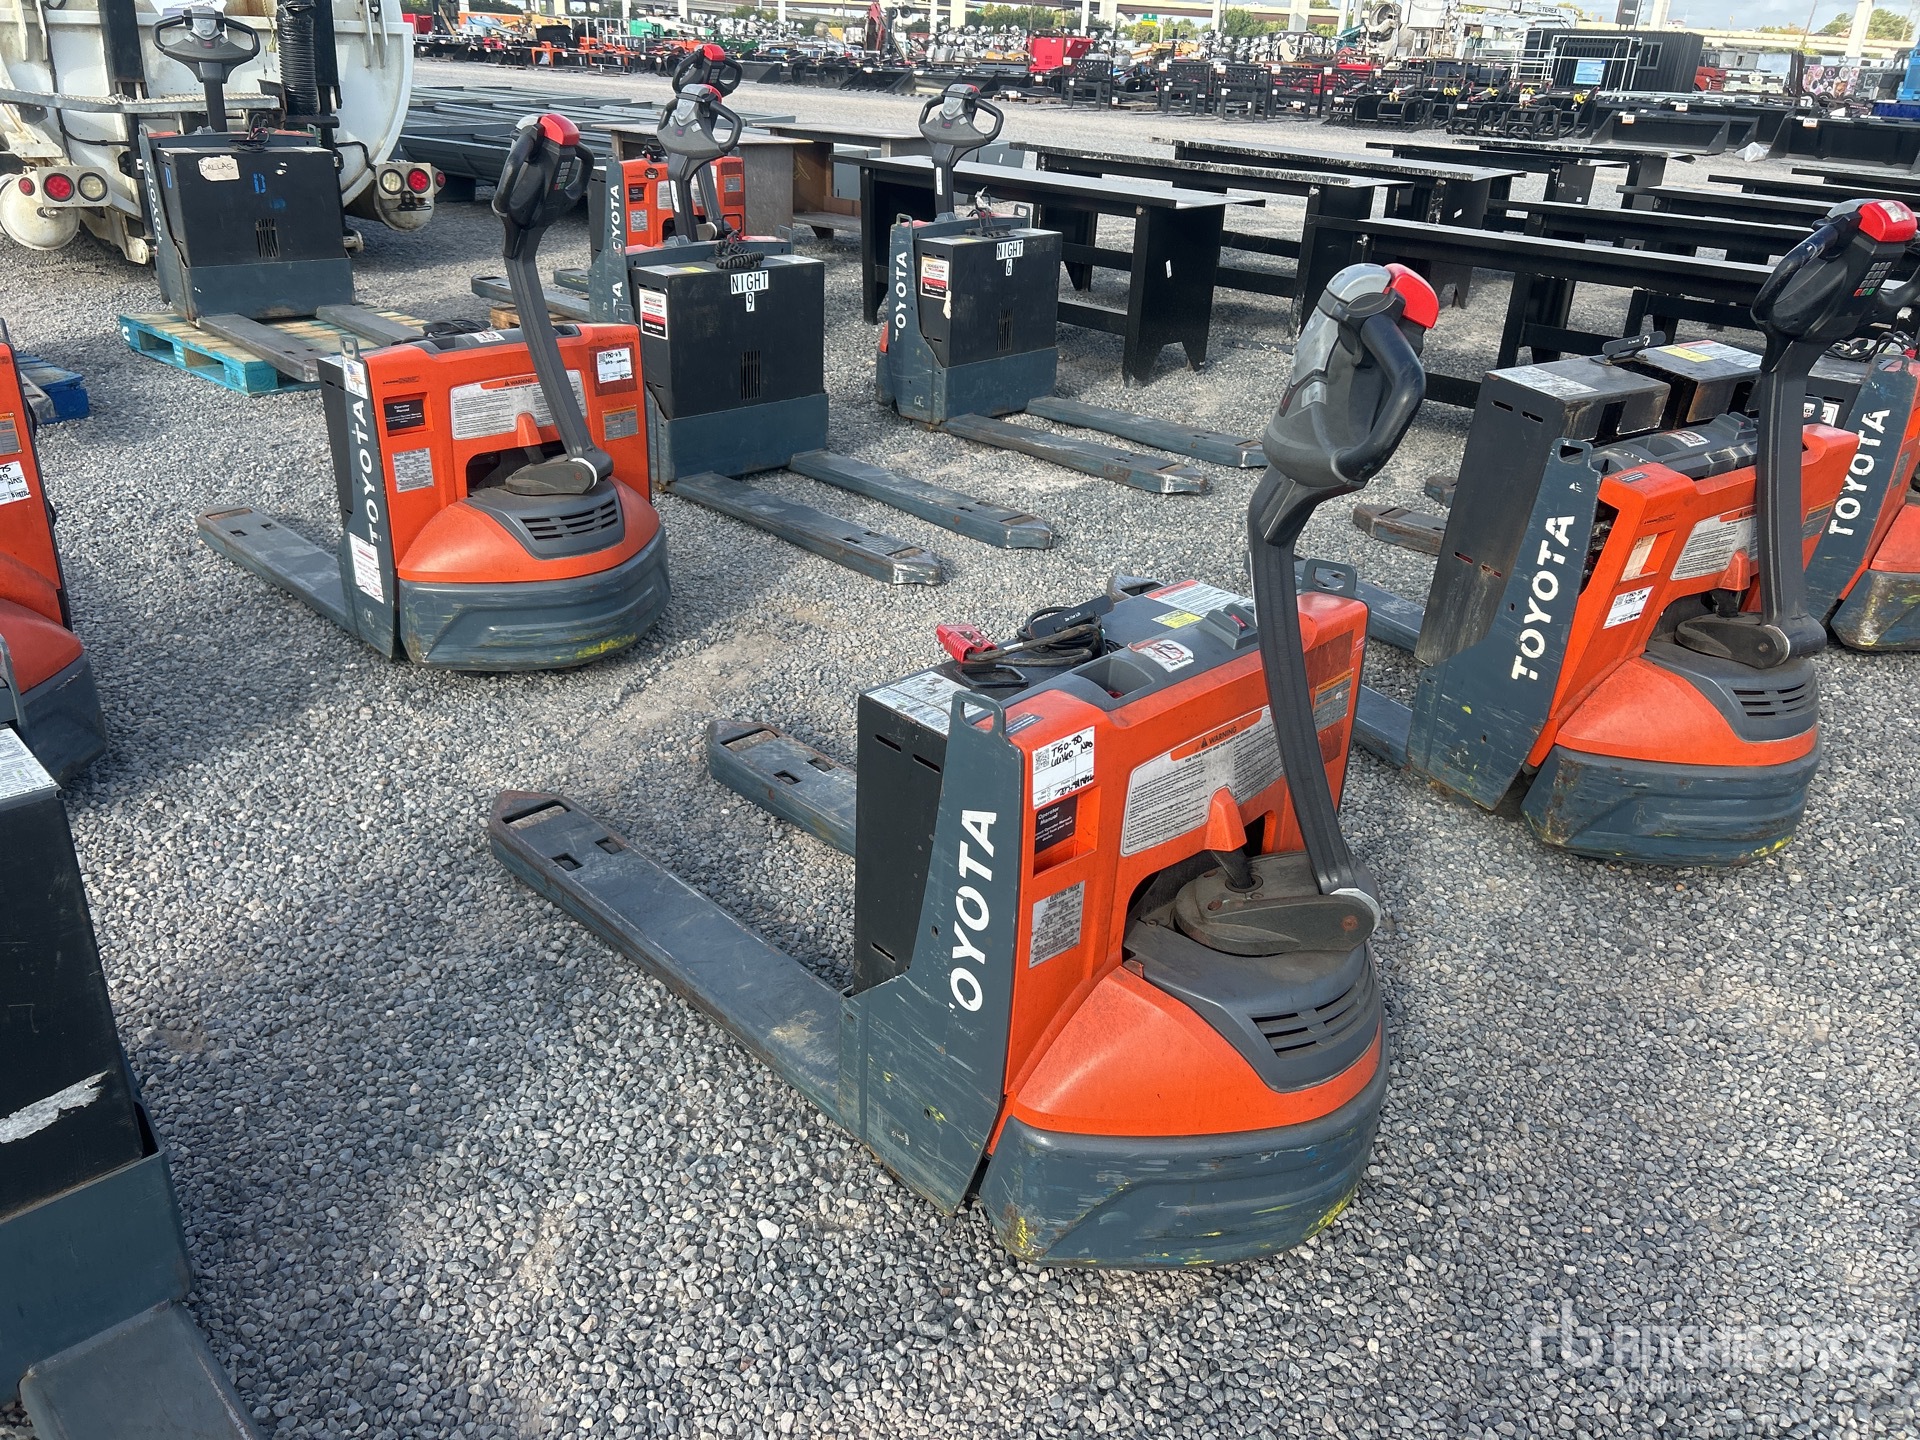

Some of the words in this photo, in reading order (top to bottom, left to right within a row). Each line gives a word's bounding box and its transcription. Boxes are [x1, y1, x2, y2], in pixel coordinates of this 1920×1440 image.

[1541, 6, 1558, 14] TEREX
[200, 162, 235, 173] DALLAS
[145, 160, 164, 244] TOYOTA
[610, 184, 622, 251] OYOTA
[998, 241, 1023, 258] NIGHT
[1006, 260, 1012, 275] 6
[731, 271, 768, 292] NIGHT
[747, 293, 754, 310] 9
[894, 251, 908, 341] TOYOTA
[352, 400, 381, 546] TOYOTA
[1828, 409, 1891, 536] TOYOTA
[1511, 515, 1576, 681] TOYOTA
[1208, 726, 1237, 745] WARNING
[1038, 806, 1060, 820] Operator
[1040, 813, 1059, 826] Manual
[949, 810, 997, 1012] OYOTA
